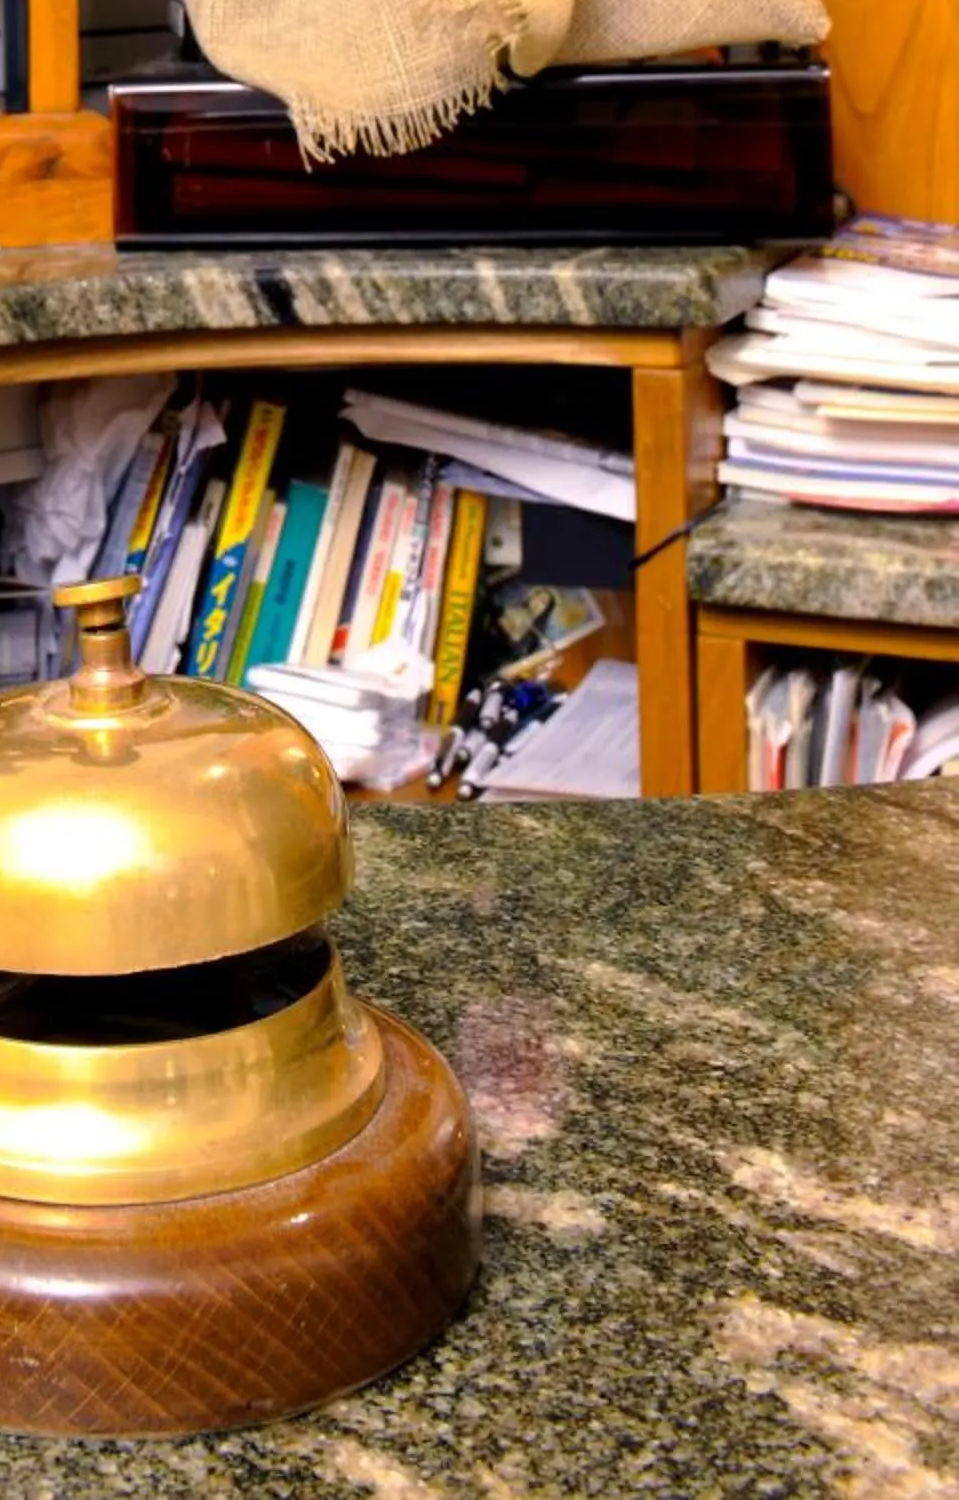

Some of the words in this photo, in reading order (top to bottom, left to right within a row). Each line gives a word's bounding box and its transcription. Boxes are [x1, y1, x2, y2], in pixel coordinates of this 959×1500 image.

[196, 572, 237, 678] イタリ
[441, 589, 470, 684] ITALIAN
